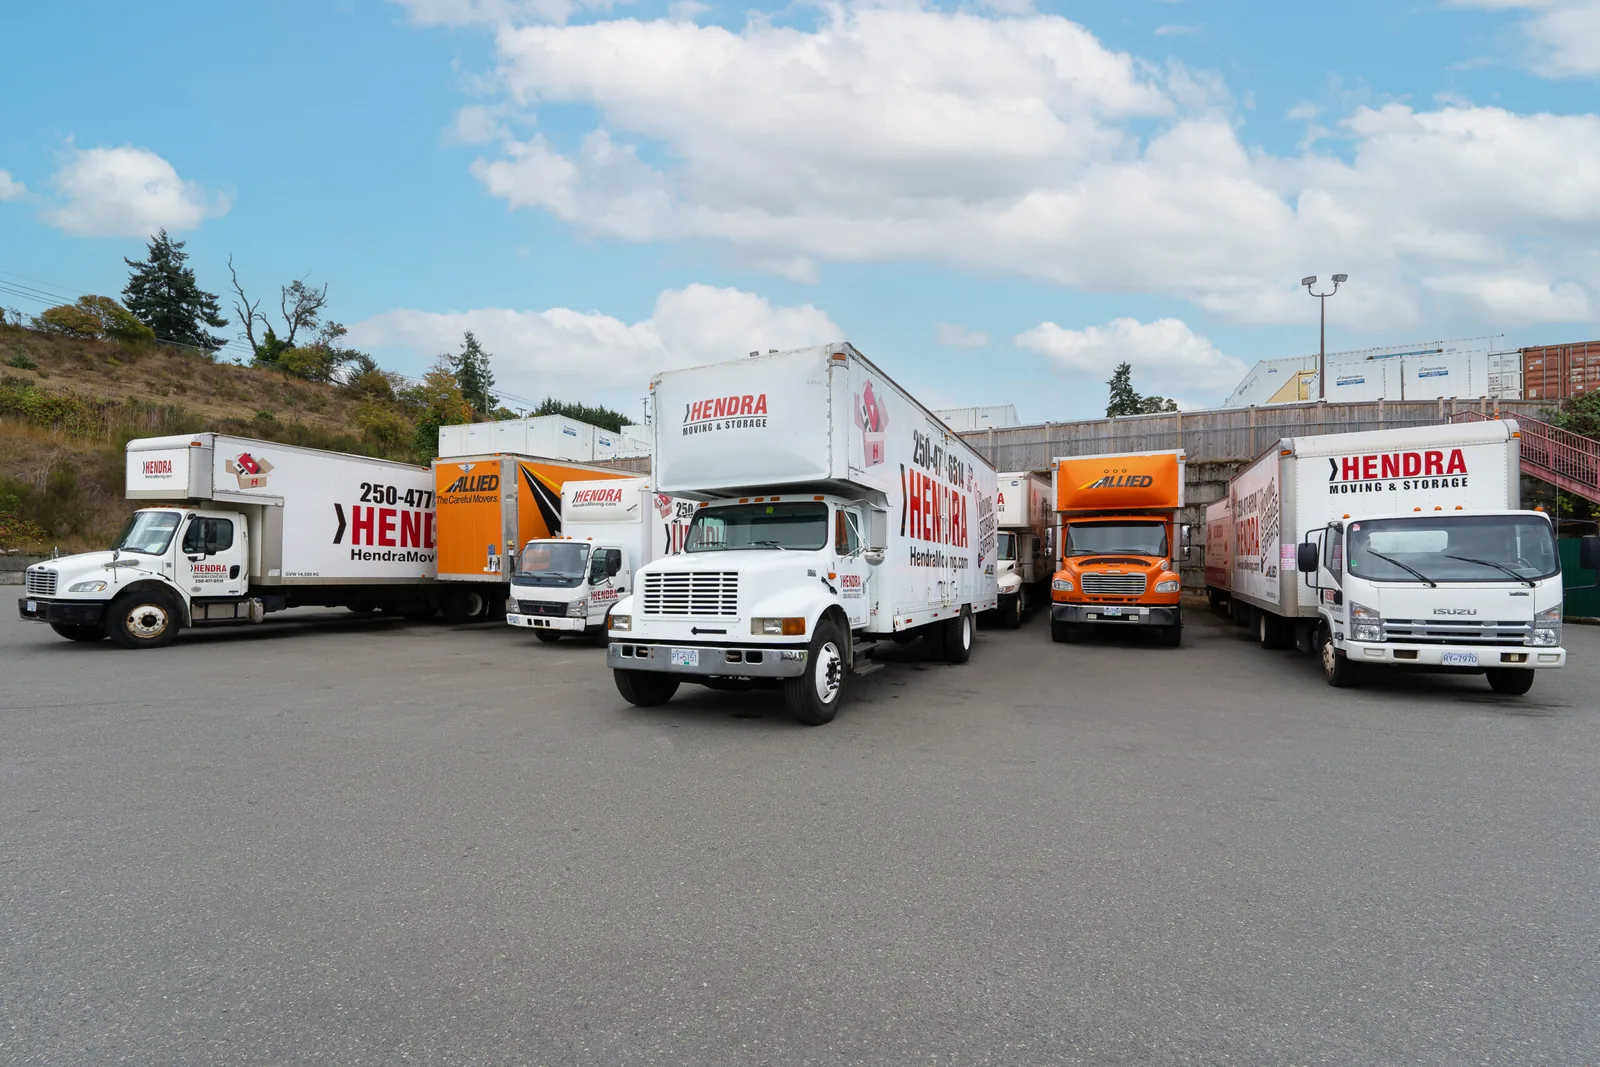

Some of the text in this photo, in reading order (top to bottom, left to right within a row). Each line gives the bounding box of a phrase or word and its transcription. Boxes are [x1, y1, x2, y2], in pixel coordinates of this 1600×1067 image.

[690, 393, 768, 422] HENDRA
[682, 418, 767, 436] MOVING & STORAGE
[145, 460, 173, 474] HENDRA
[1341, 448, 1468, 481] HENDRA
[445, 474, 500, 493] ALLIED
[1086, 475, 1153, 489] ALLIED
[1329, 477, 1468, 494] MOVING & STORAGE
[436, 495, 448, 505] The
[448, 494, 473, 505] Careful
[575, 488, 623, 503] HENDRA
[909, 468, 969, 549] HENDRA
[193, 564, 227, 573] HENDRA
[592, 589, 619, 601] HENDRA
[1432, 608, 1478, 616] ISUZU
[1443, 654, 1478, 664] RY-7970
